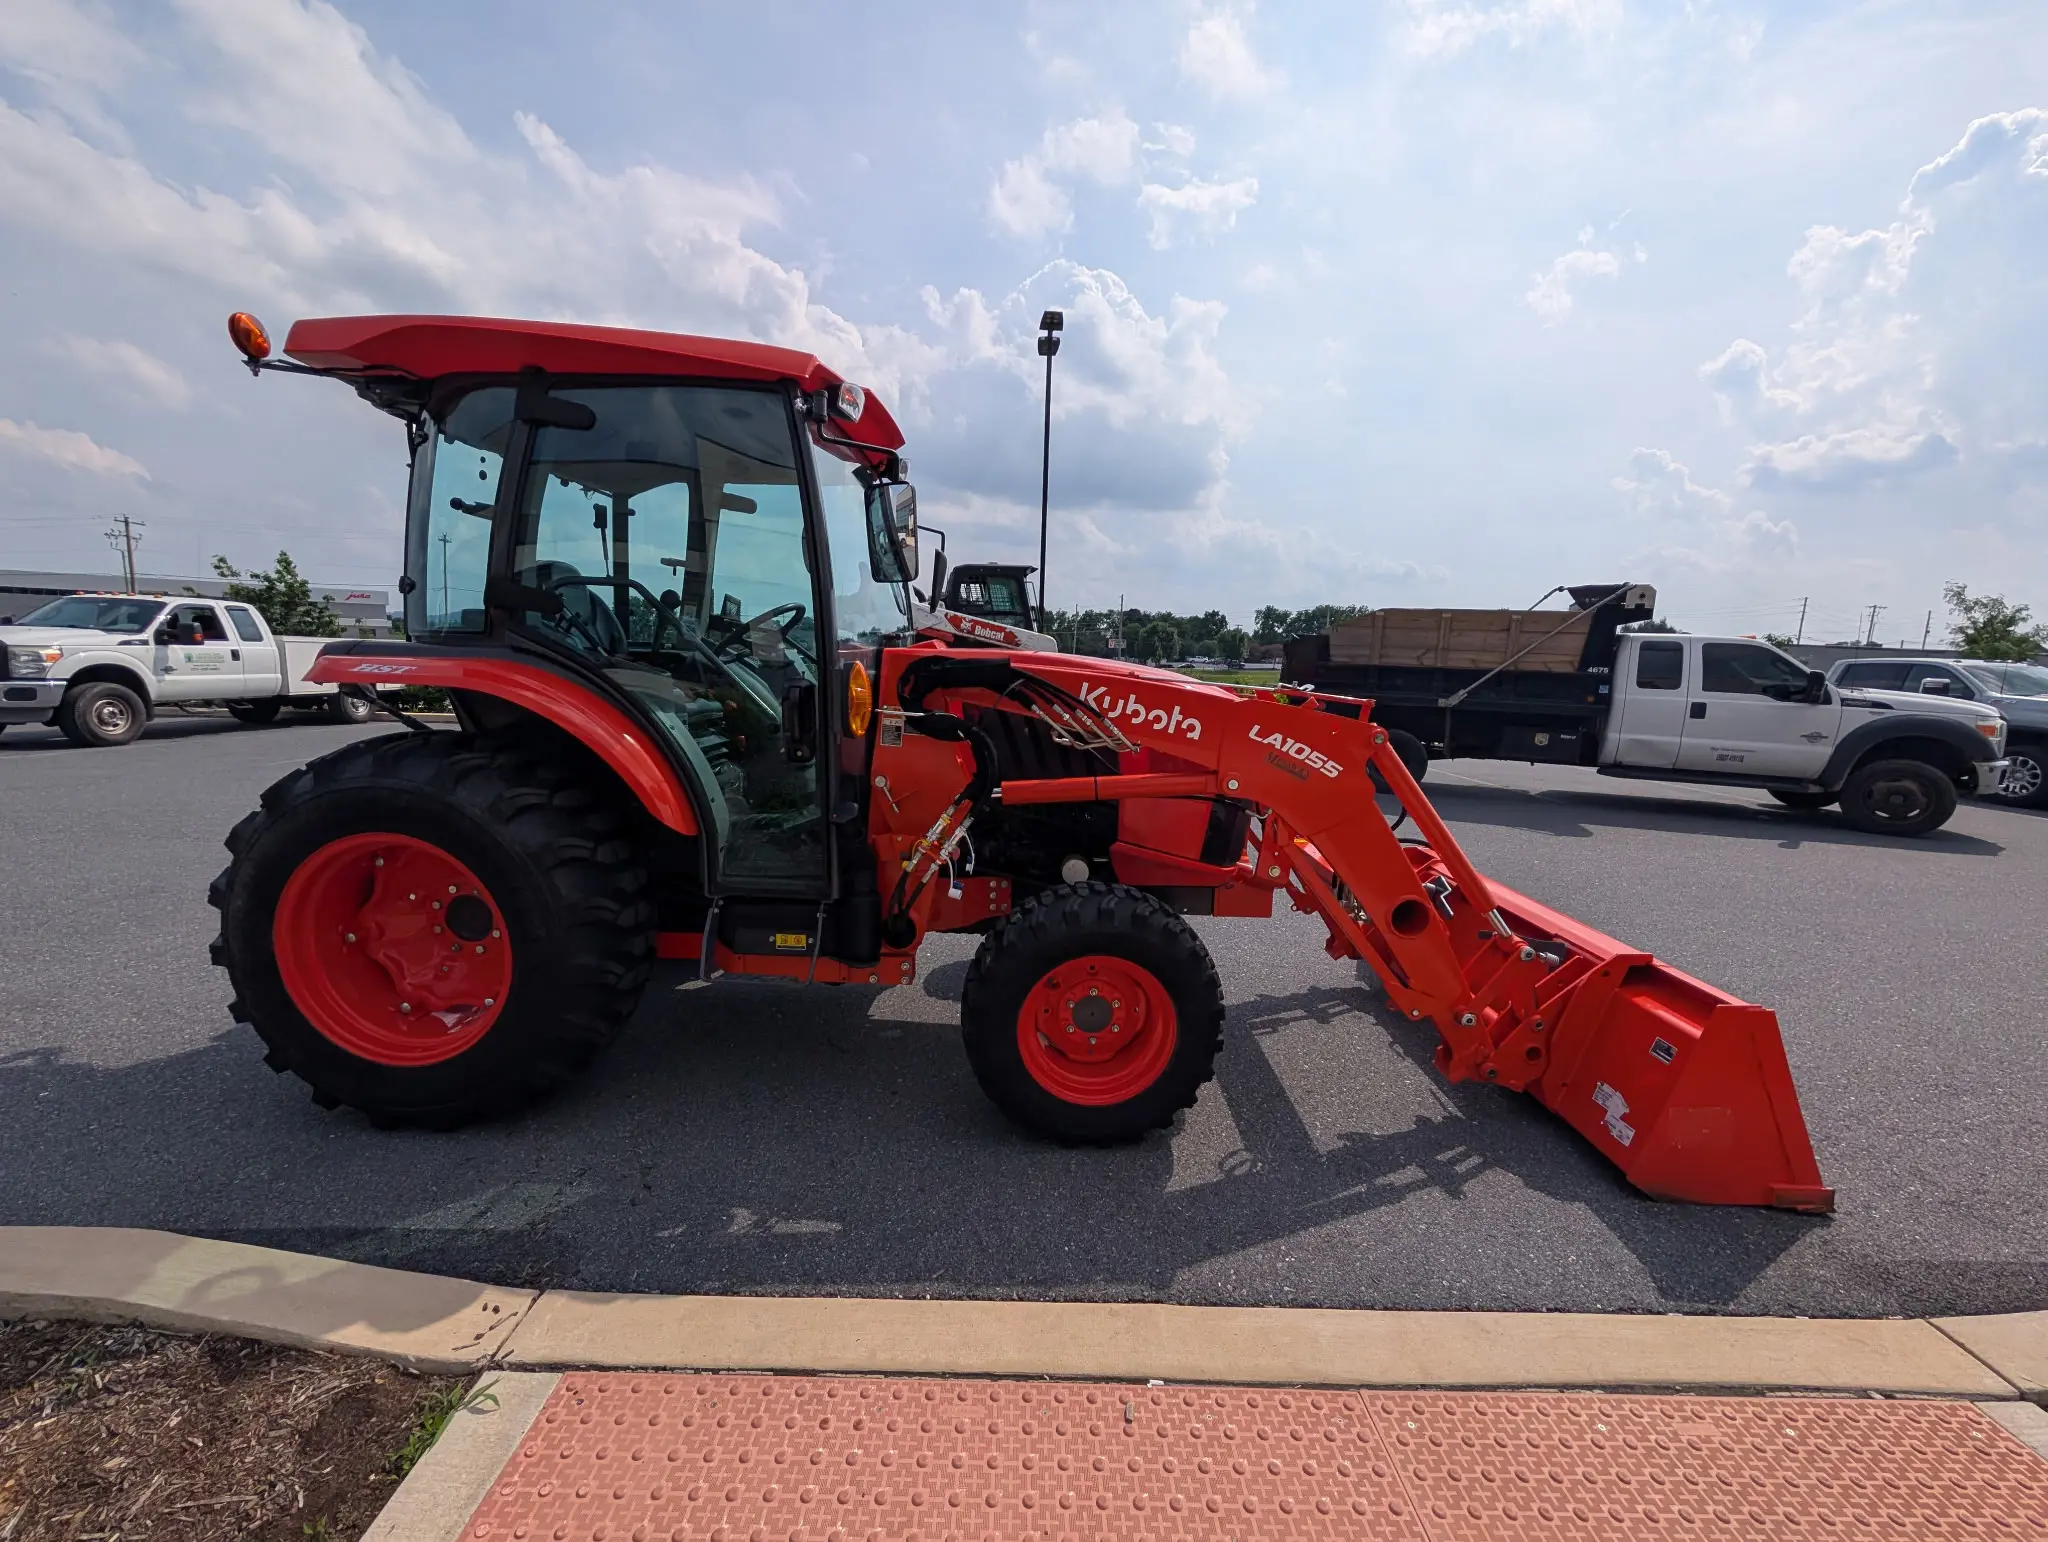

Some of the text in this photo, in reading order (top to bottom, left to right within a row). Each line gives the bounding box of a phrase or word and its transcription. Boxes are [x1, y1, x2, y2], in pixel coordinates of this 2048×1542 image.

[974, 624, 1005, 642] Bobcat
[348, 663, 417, 674] HST
[1079, 682, 1202, 741] Kubota
[1248, 725, 1344, 779] LA1055
